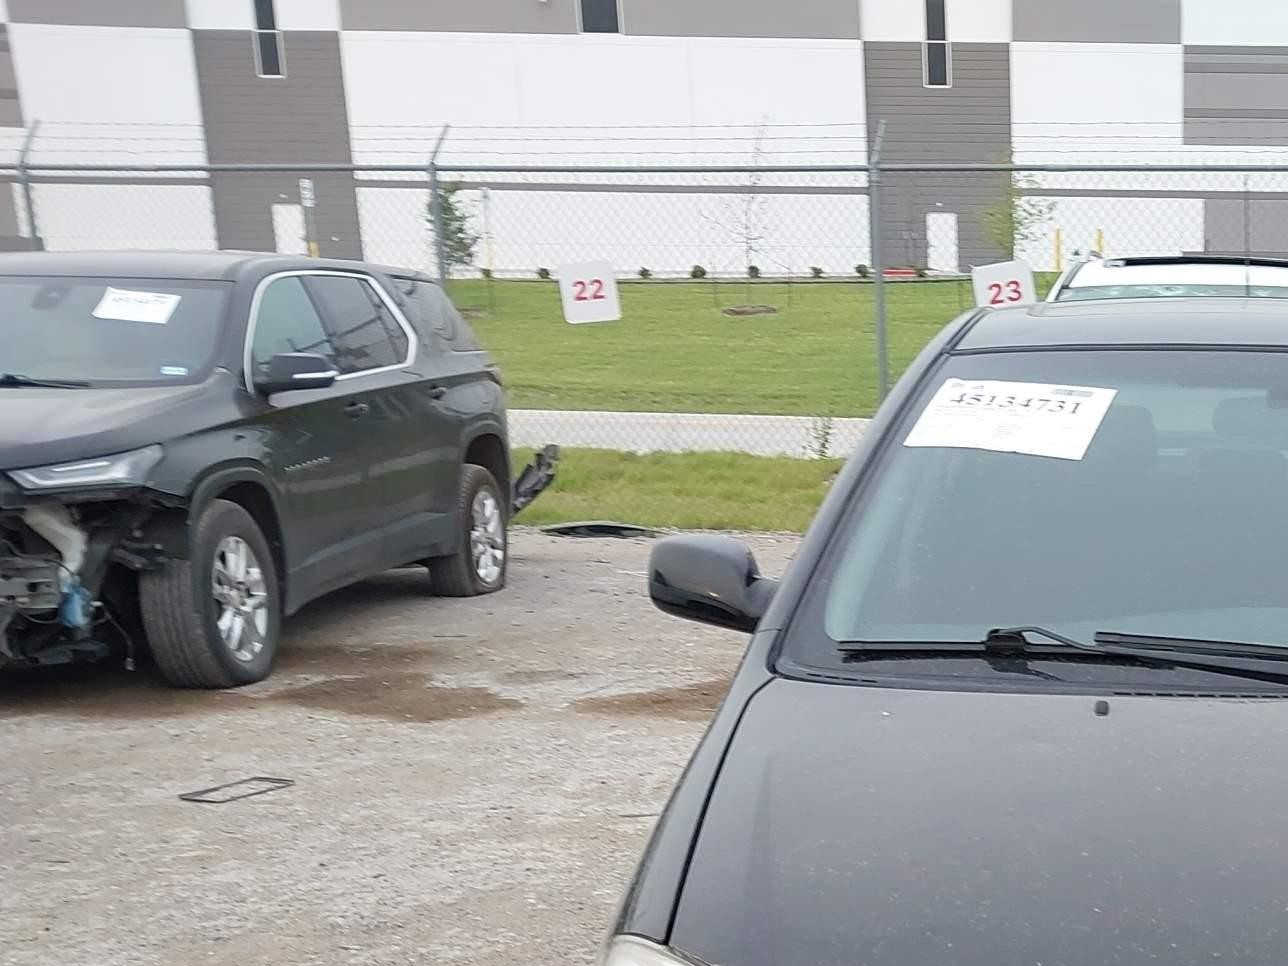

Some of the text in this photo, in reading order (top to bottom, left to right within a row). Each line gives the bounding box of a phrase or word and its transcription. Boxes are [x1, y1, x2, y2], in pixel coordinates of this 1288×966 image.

[573, 280, 604, 301] 22
[988, 281, 1021, 305] 23
[950, 391, 1083, 414] 45134731
